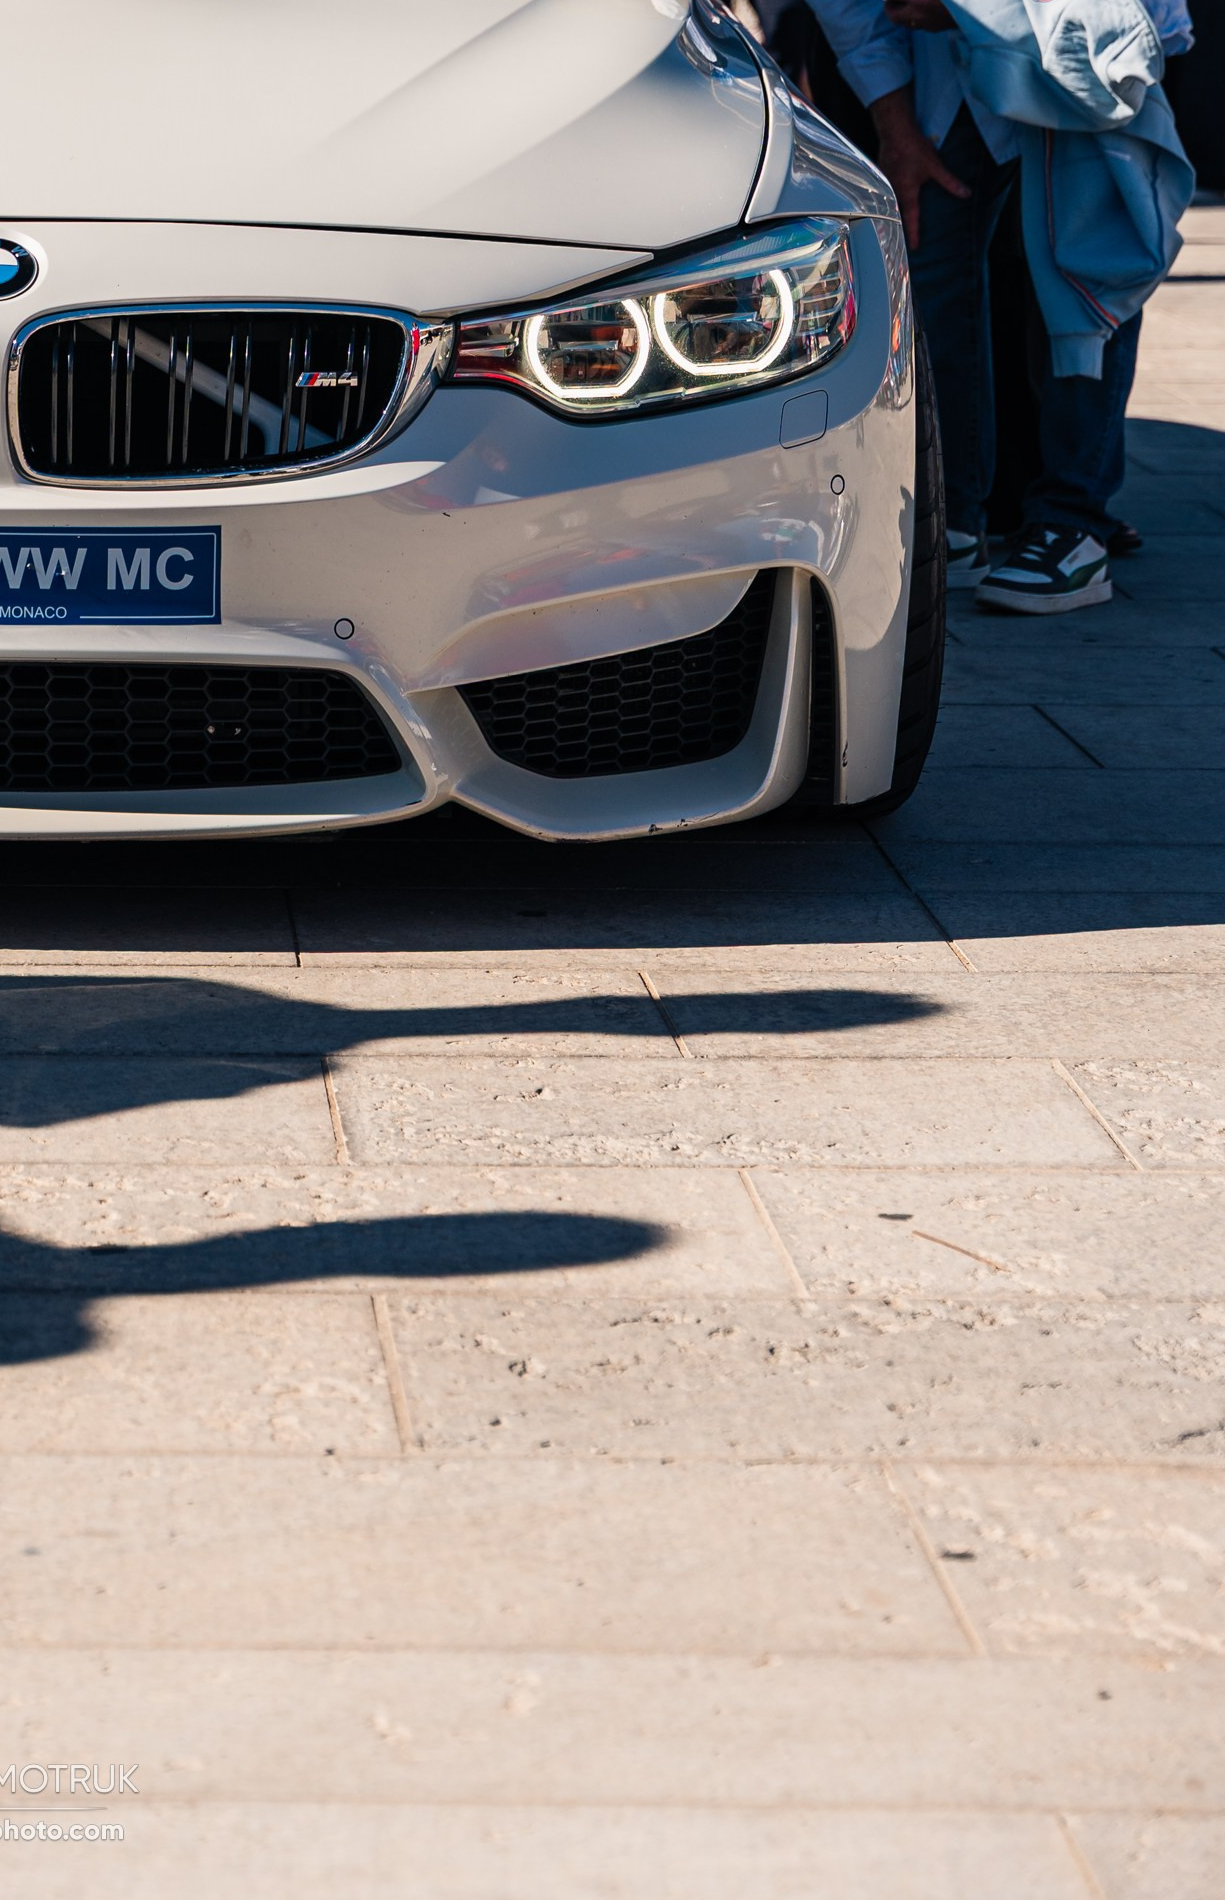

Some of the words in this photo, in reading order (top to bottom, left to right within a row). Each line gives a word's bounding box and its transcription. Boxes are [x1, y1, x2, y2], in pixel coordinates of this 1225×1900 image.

[311, 371, 358, 387] M4
[107, 546, 195, 590] MC
[0, 606, 67, 619] MONACO
